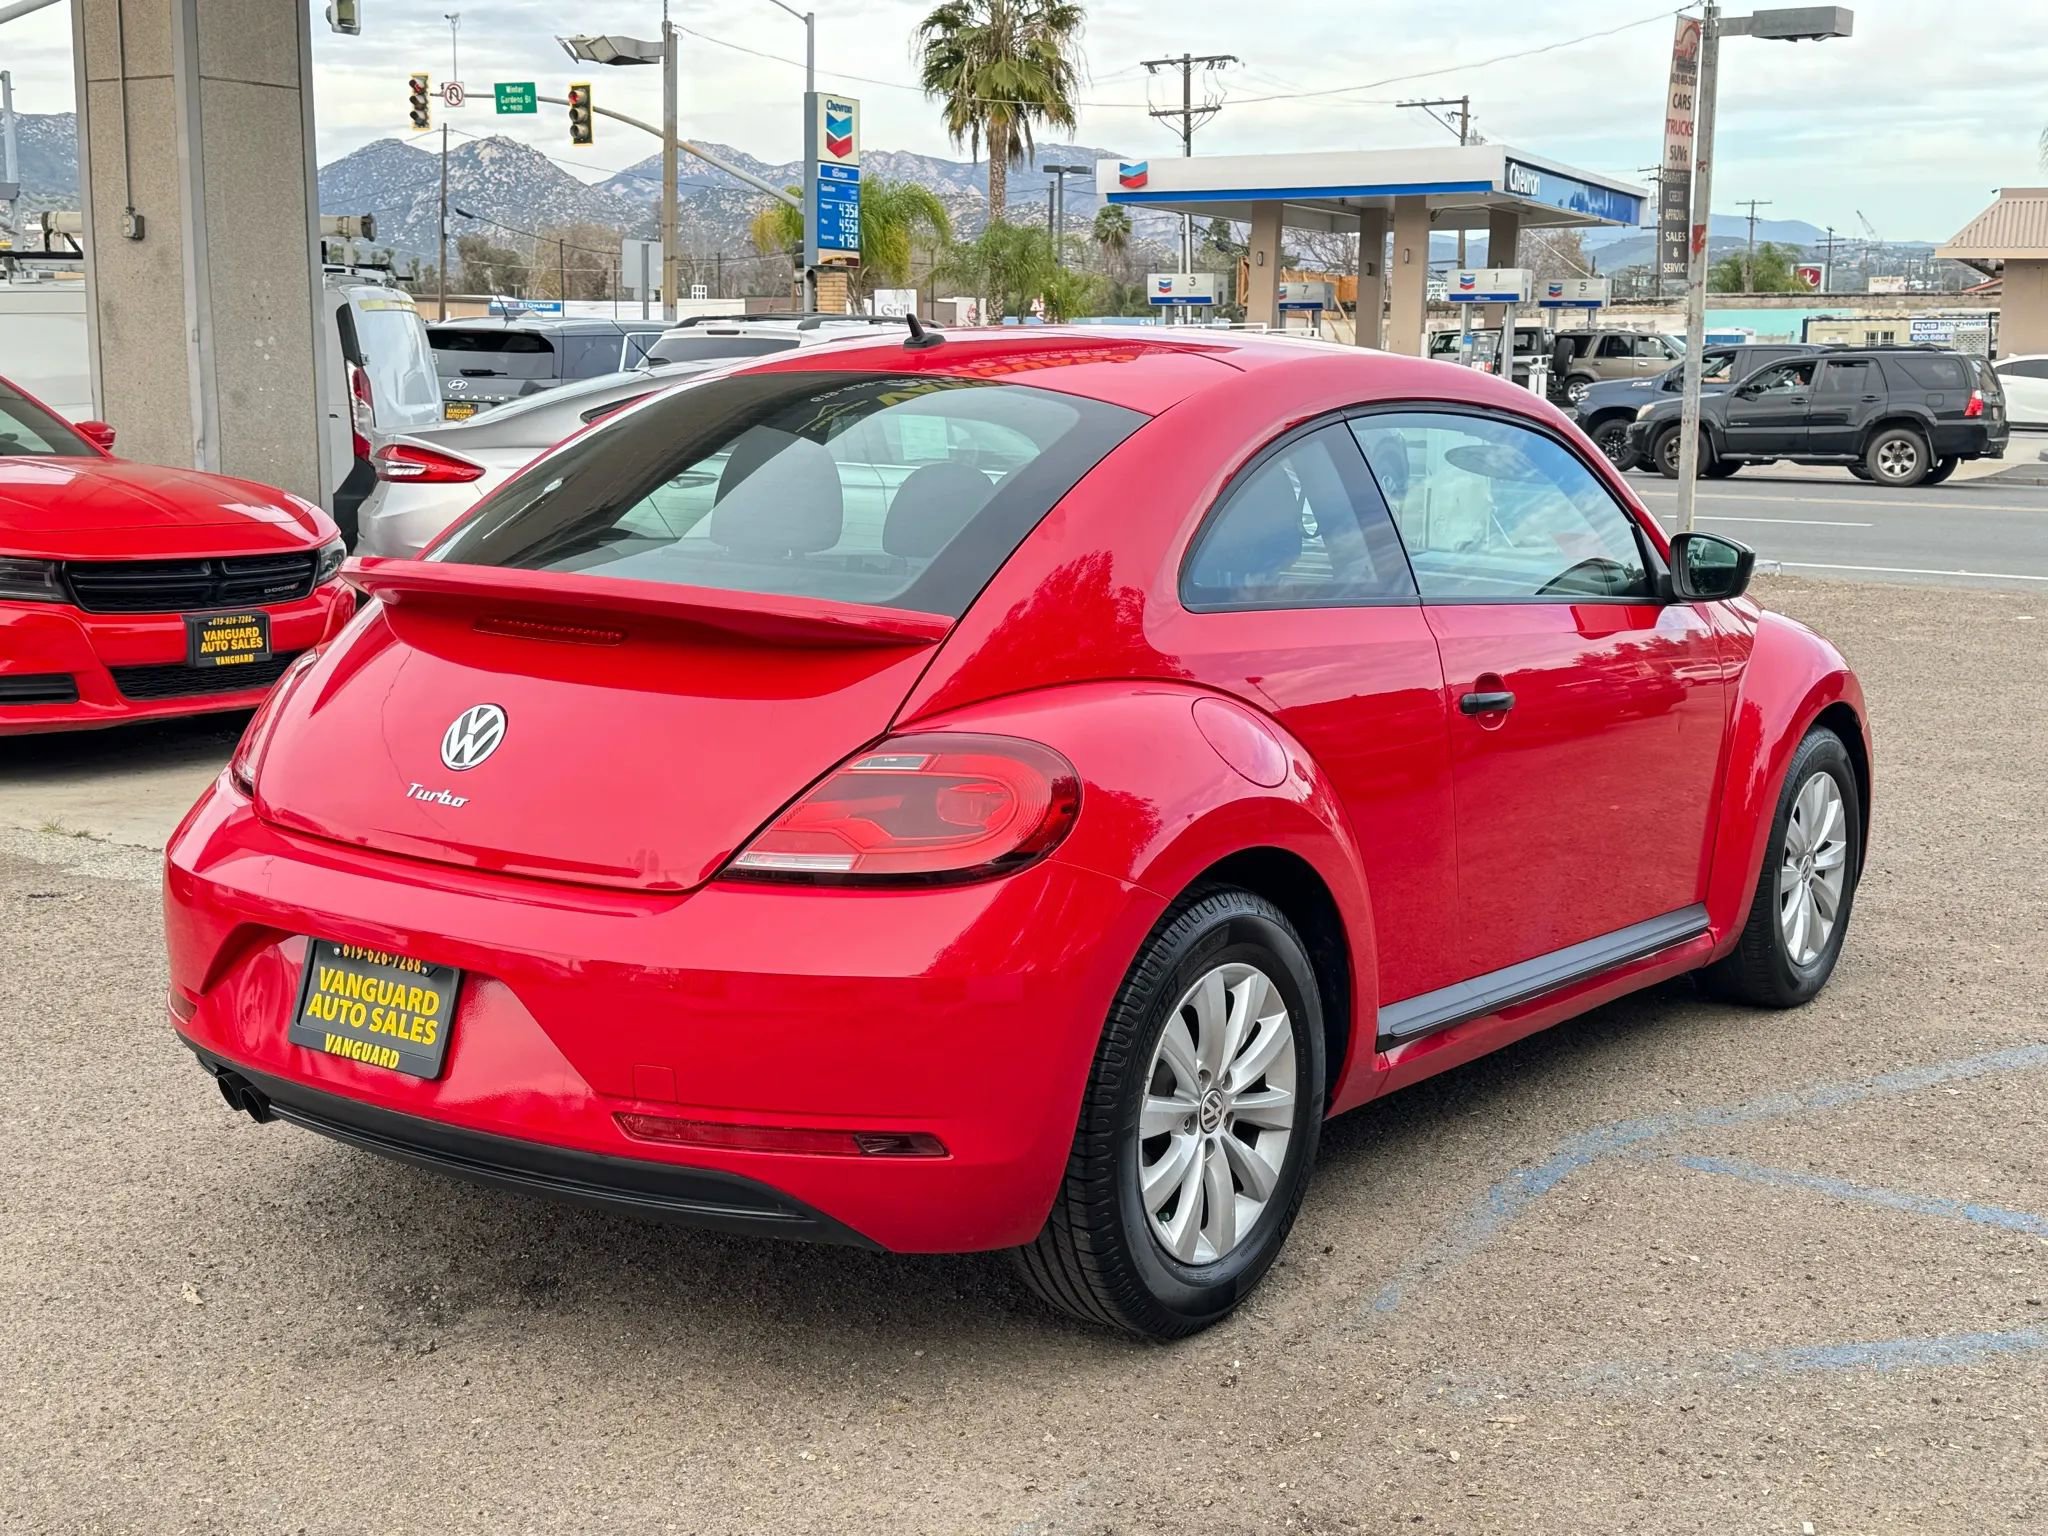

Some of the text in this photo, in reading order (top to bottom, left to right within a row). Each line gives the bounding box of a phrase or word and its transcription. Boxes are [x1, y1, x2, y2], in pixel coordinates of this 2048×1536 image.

[826, 99, 853, 115] Chevron
[1672, 93, 1692, 111] CARS
[1666, 118, 1694, 137] TRUCKS
[1509, 162, 1541, 195] Chevron
[1665, 231, 1686, 242] SALES
[1663, 262, 1687, 273] SERVIC
[1189, 276, 1196, 287] 3
[1494, 273, 1498, 283] 1
[1302, 285, 1308, 294] 7
[1579, 281, 1587, 292] 5
[880, 303, 910, 316] Grill
[203, 627, 260, 642] VANGUARD
[201, 637, 263, 654] AUTO SALES
[216, 653, 254, 666] VANGUARD
[406, 782, 471, 808] Turbo
[320, 966, 440, 1016] VANGUARD
[306, 993, 439, 1046] AUTO SALES
[325, 1033, 400, 1070] VANGUARD
